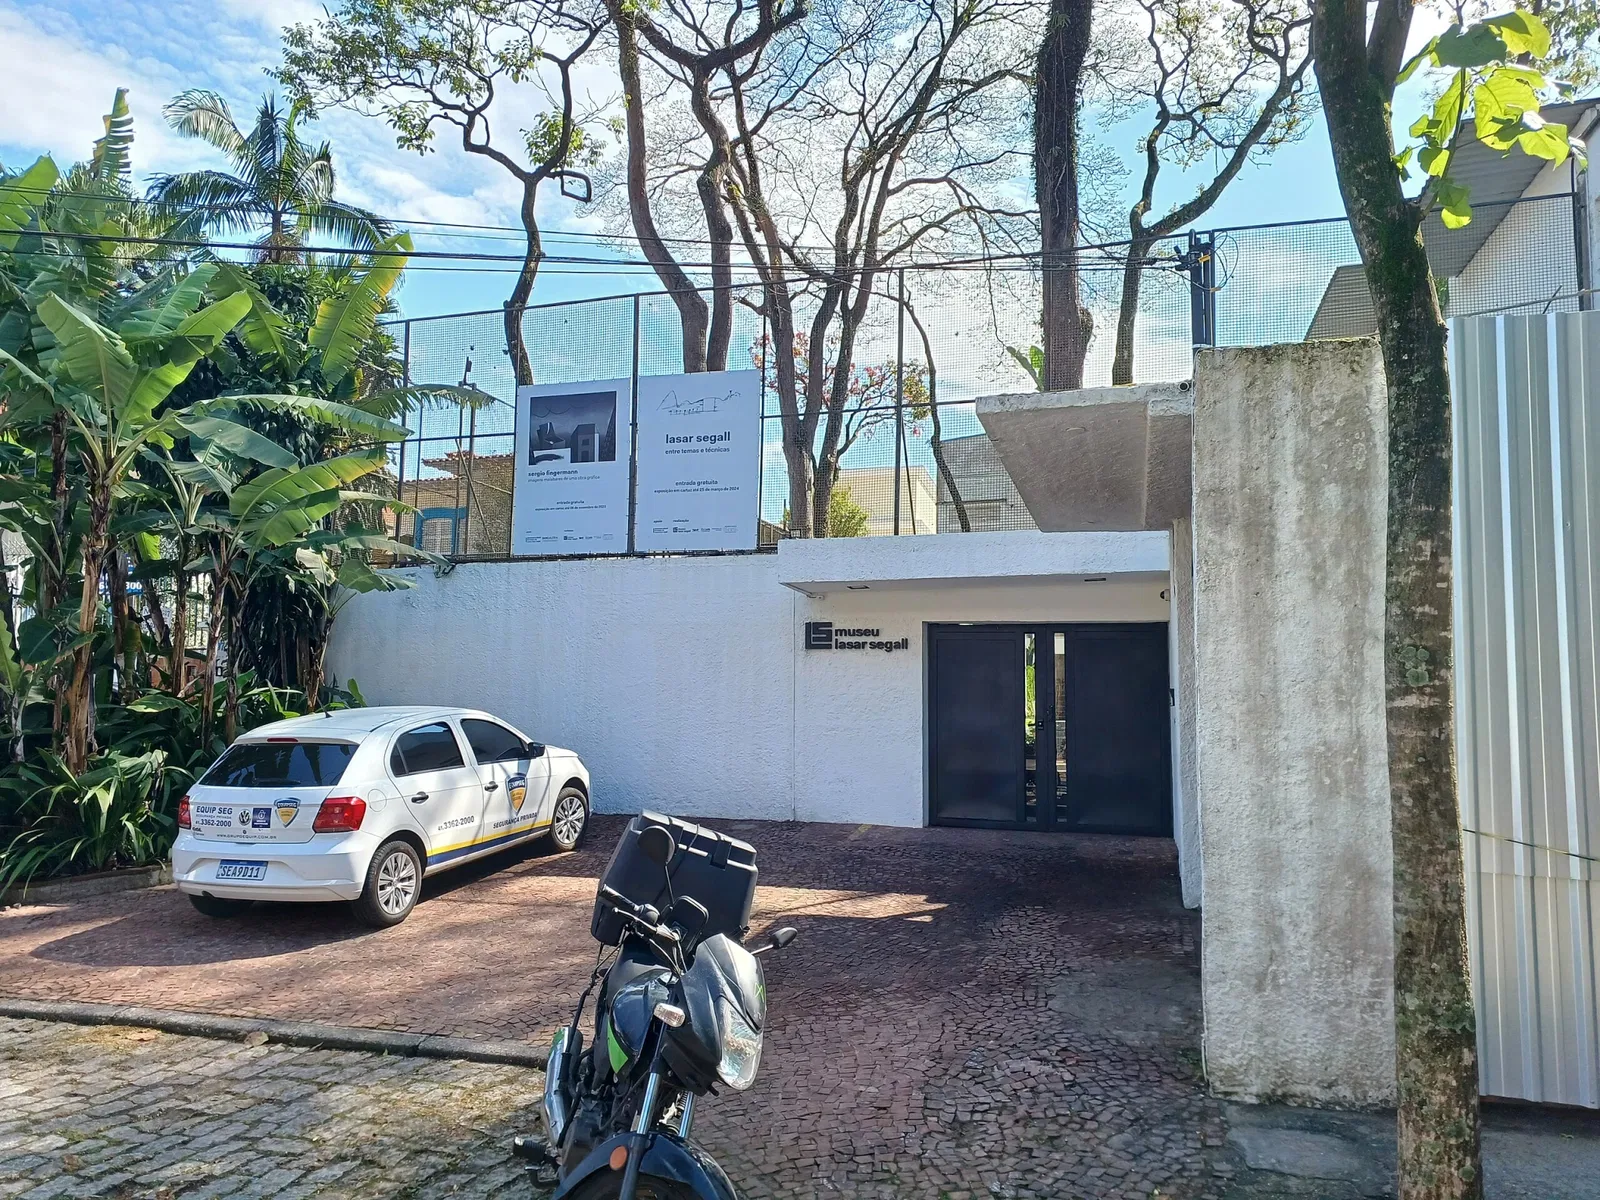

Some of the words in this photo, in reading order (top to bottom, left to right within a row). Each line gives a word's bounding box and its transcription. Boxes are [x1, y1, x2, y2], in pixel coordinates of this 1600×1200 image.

[665, 433, 694, 444] lasar
[696, 431, 731, 444] segall
[835, 628, 879, 637] museu
[835, 638, 868, 650] lasar
[868, 637, 908, 653] segall
[196, 805, 216, 814] EQUIP
[217, 806, 233, 815] SEG
[493, 816, 520, 829] SEGURANÇA
[220, 866, 261, 878] SEA9D11
